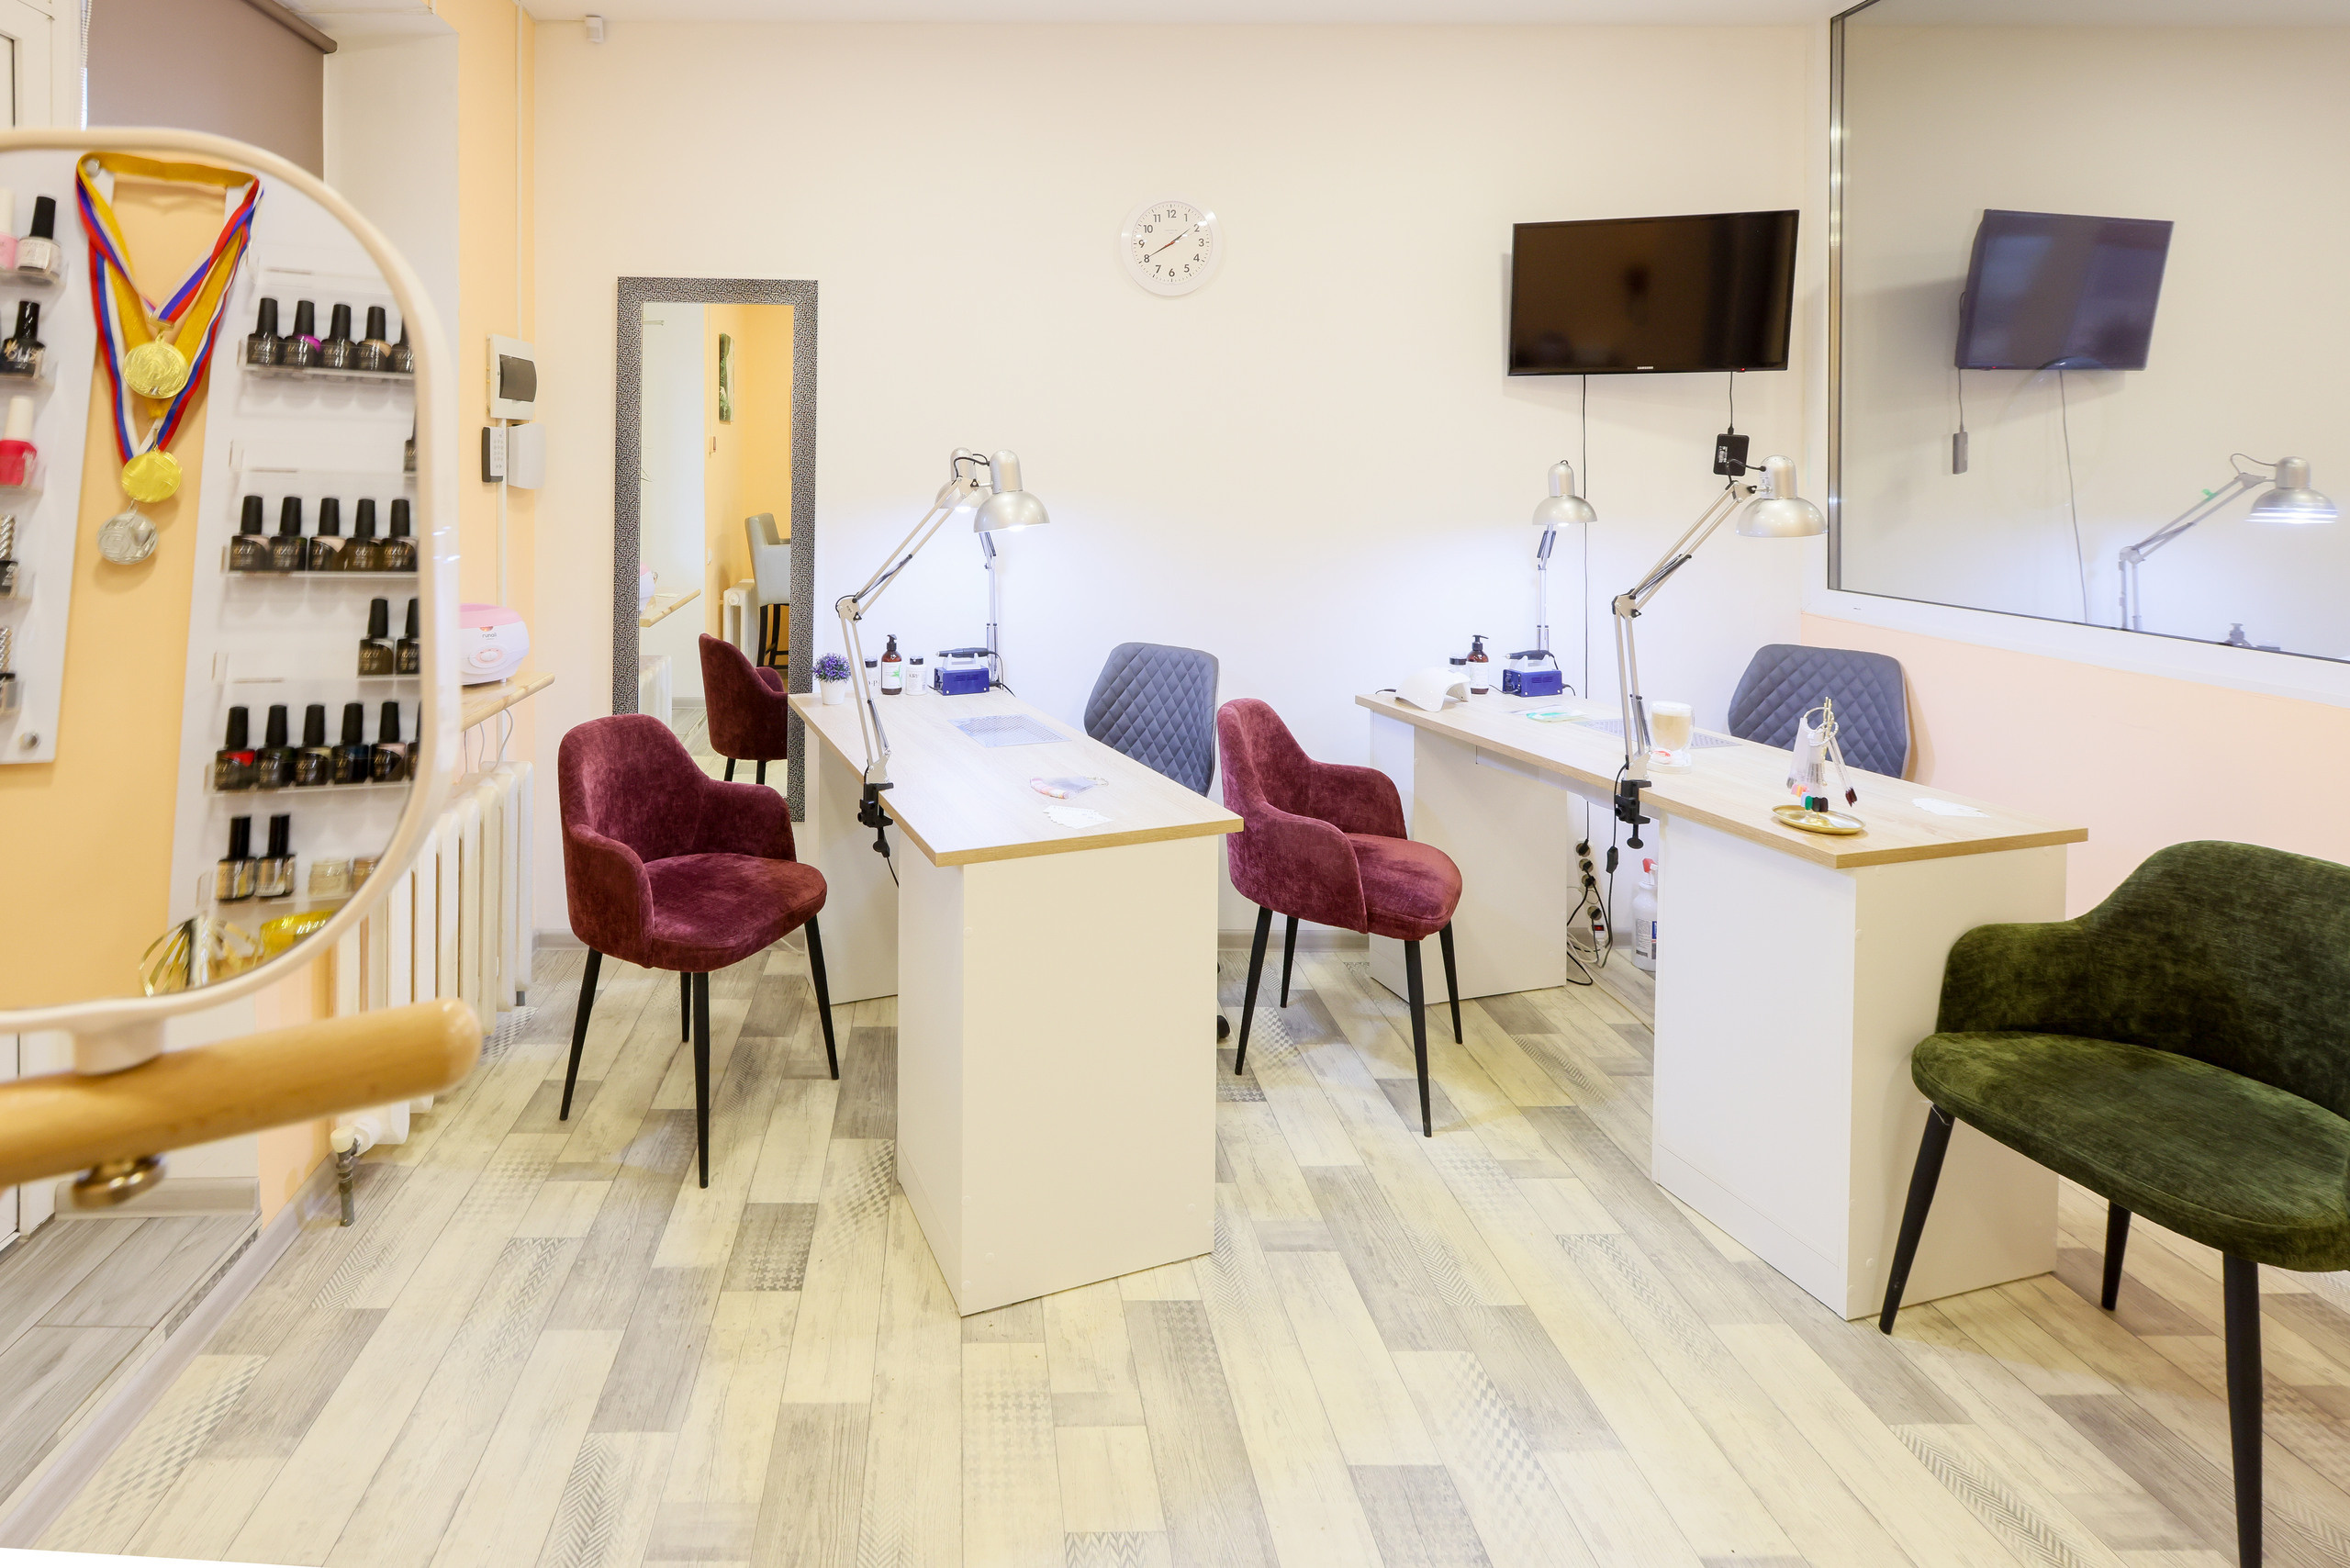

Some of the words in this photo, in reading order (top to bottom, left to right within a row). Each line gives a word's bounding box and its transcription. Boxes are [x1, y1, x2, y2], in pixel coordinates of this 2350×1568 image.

[1167, 209, 1177, 218] 12
[1183, 214, 1188, 222] 1
[1153, 214, 1161, 223] 11
[1143, 225, 1154, 233] 10
[1193, 224, 1200, 232] 2
[1138, 240, 1145, 248] 9
[1198, 239, 1204, 247] 3
[1144, 254, 1150, 263] 8
[1192, 253, 1200, 263] 4
[1155, 264, 1161, 274] 7
[1169, 268, 1175, 277] 6
[1183, 264, 1190, 273] 5
